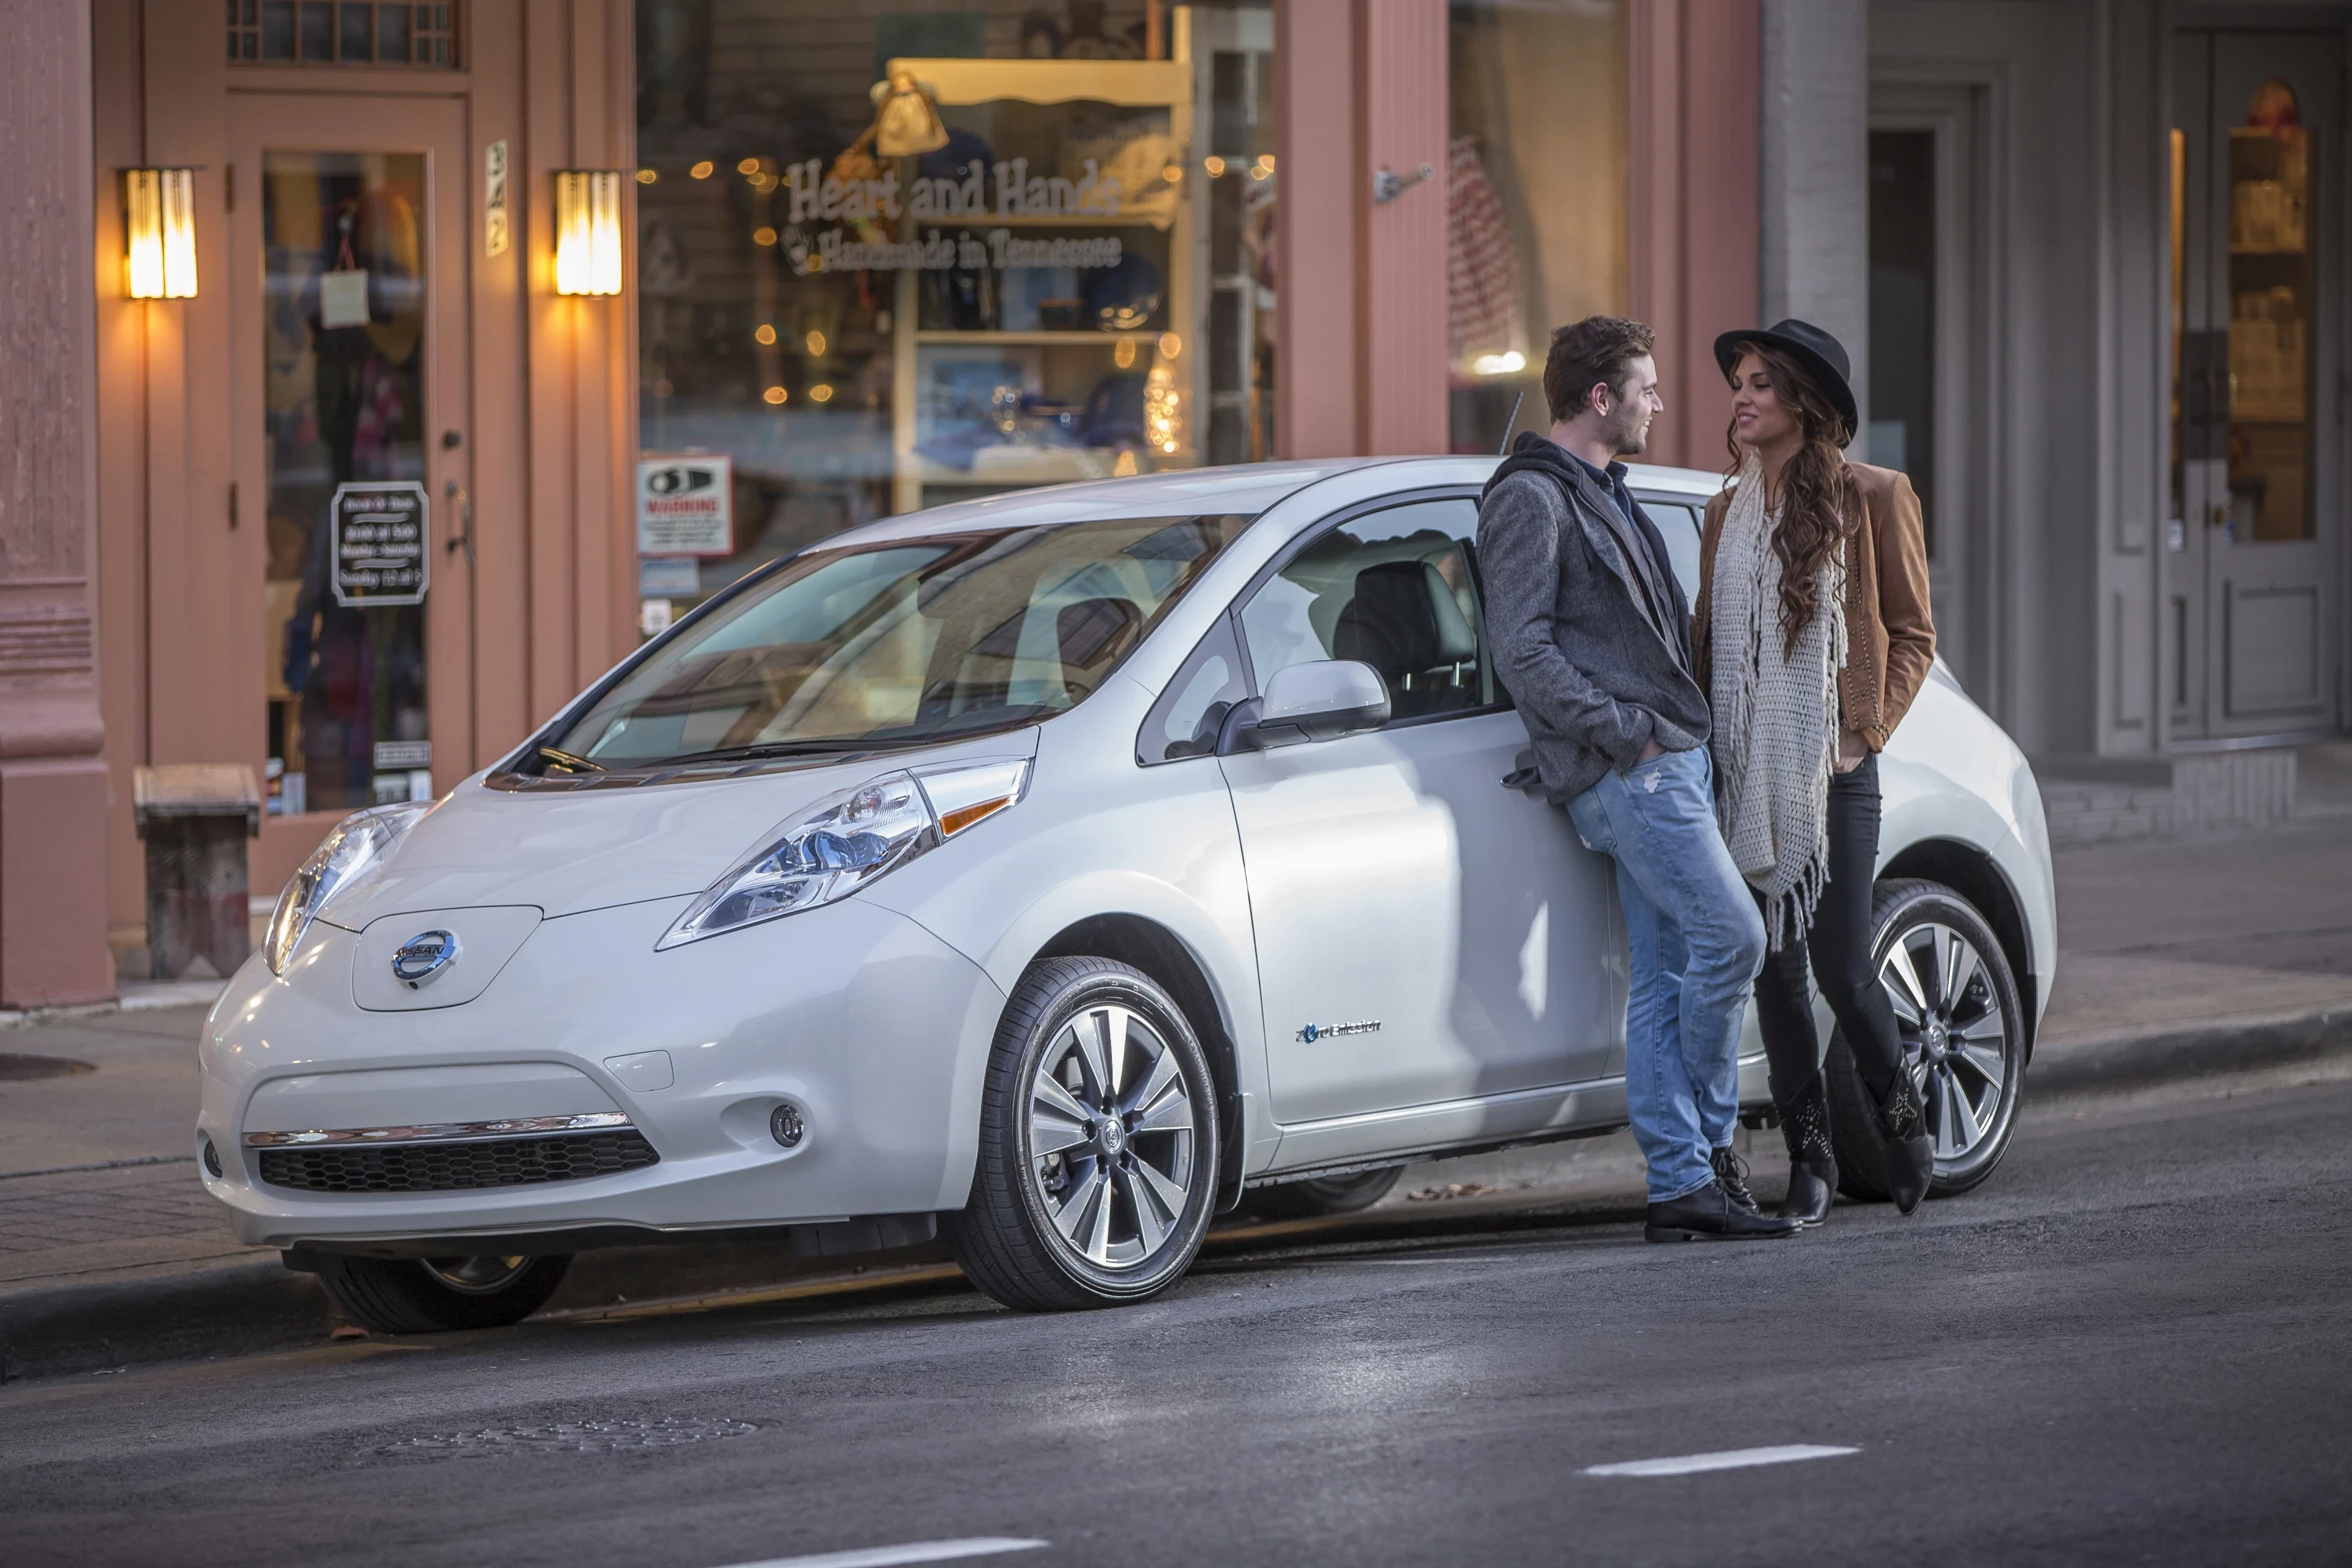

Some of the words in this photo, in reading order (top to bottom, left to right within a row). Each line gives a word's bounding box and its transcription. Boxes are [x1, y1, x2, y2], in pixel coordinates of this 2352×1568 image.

[787, 158, 902, 223] Heart
[910, 159, 988, 220] and
[993, 158, 1123, 220] Hands
[818, 230, 956, 272] Handmade
[957, 231, 986, 269] in
[988, 228, 1123, 269] Tennessee
[647, 498, 718, 514] WARNING
[1330, 1020, 1381, 1037] Emission
